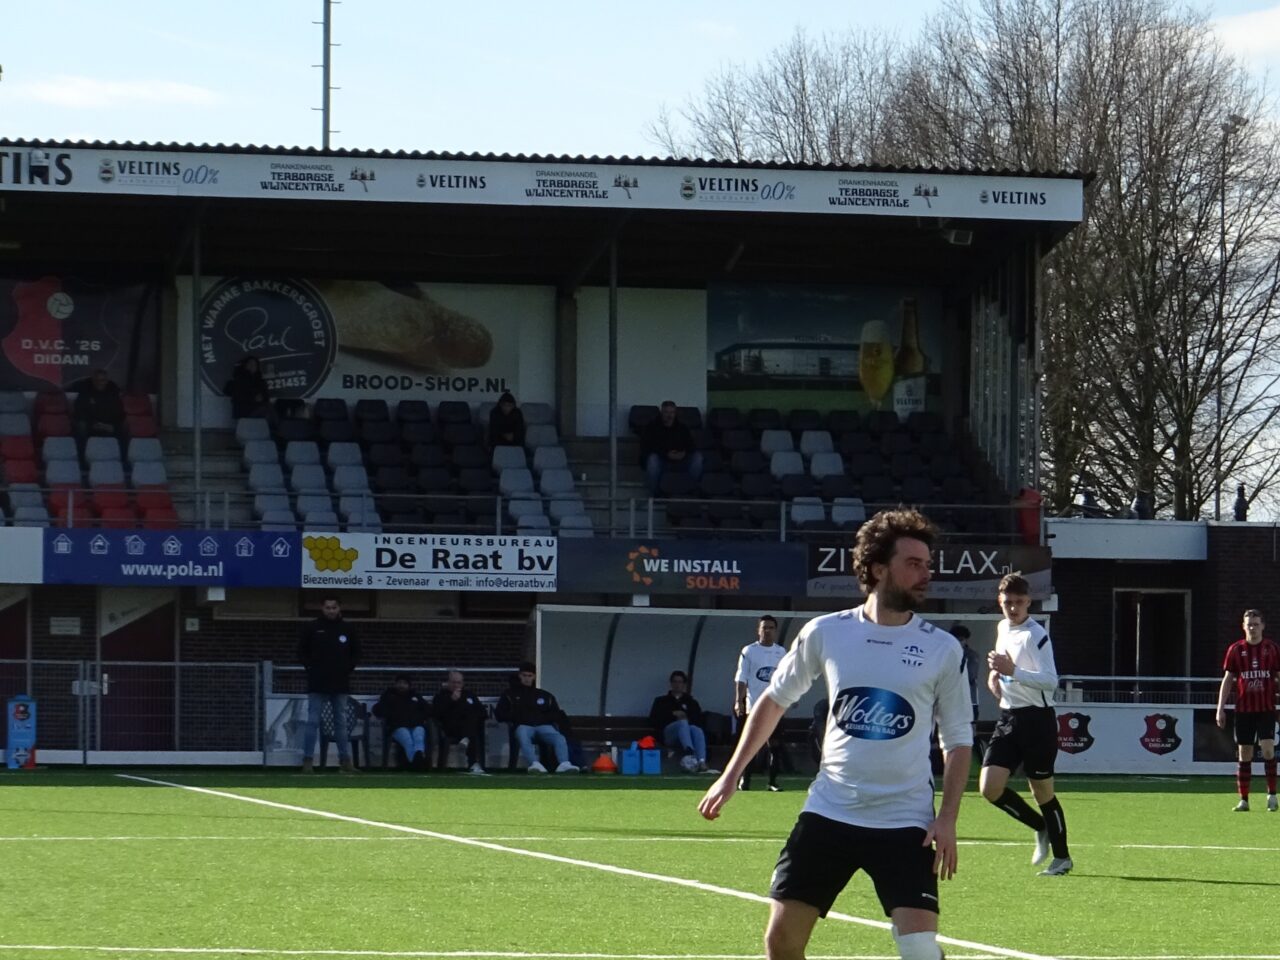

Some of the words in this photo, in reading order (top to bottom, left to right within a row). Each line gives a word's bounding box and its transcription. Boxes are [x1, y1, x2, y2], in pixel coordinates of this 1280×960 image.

[117, 161, 180, 175] VELTINS
[535, 170, 599, 179] DRANKENHANDEL
[270, 172, 334, 182] TERBORGSE
[430, 175, 486, 189] VELTINS
[536, 179, 599, 189] TERBORGSE
[260, 182, 344, 192] WIJNCENTRALE
[698, 177, 759, 192] VELTINS
[525, 189, 609, 199] WIJNCENTRALE
[838, 188, 899, 198] TERBORGSE
[992, 191, 1046, 205] VELTINS
[828, 197, 910, 207] WIJNCENTRALE
[203, 286, 241, 329] WARME
[241, 280, 326, 347] BAKKERSGROET
[21, 339, 70, 350] D.V.C.
[201, 334, 216, 364] MET
[33, 354, 89, 365] DIDAM
[342, 375, 510, 393] BROOD-SHOP.NL
[374, 536, 554, 547] INGENIEURSBUREAU
[375, 547, 416, 568] De
[432, 548, 503, 570] Raat
[518, 549, 554, 570] bv
[643, 558, 670, 572] WE
[673, 559, 742, 573] INSTALL
[928, 549, 1013, 575] LAX.nl
[121, 561, 223, 579] www.pola.nl
[303, 575, 363, 585] Biezenweide
[367, 576, 373, 585] 8
[386, 576, 430, 586] Zevenaar
[439, 577, 472, 587] e-mail:
[475, 577, 556, 588] info@deraatbv.nl
[686, 576, 740, 590] SOLAR
[836, 694, 912, 729] Wolters
